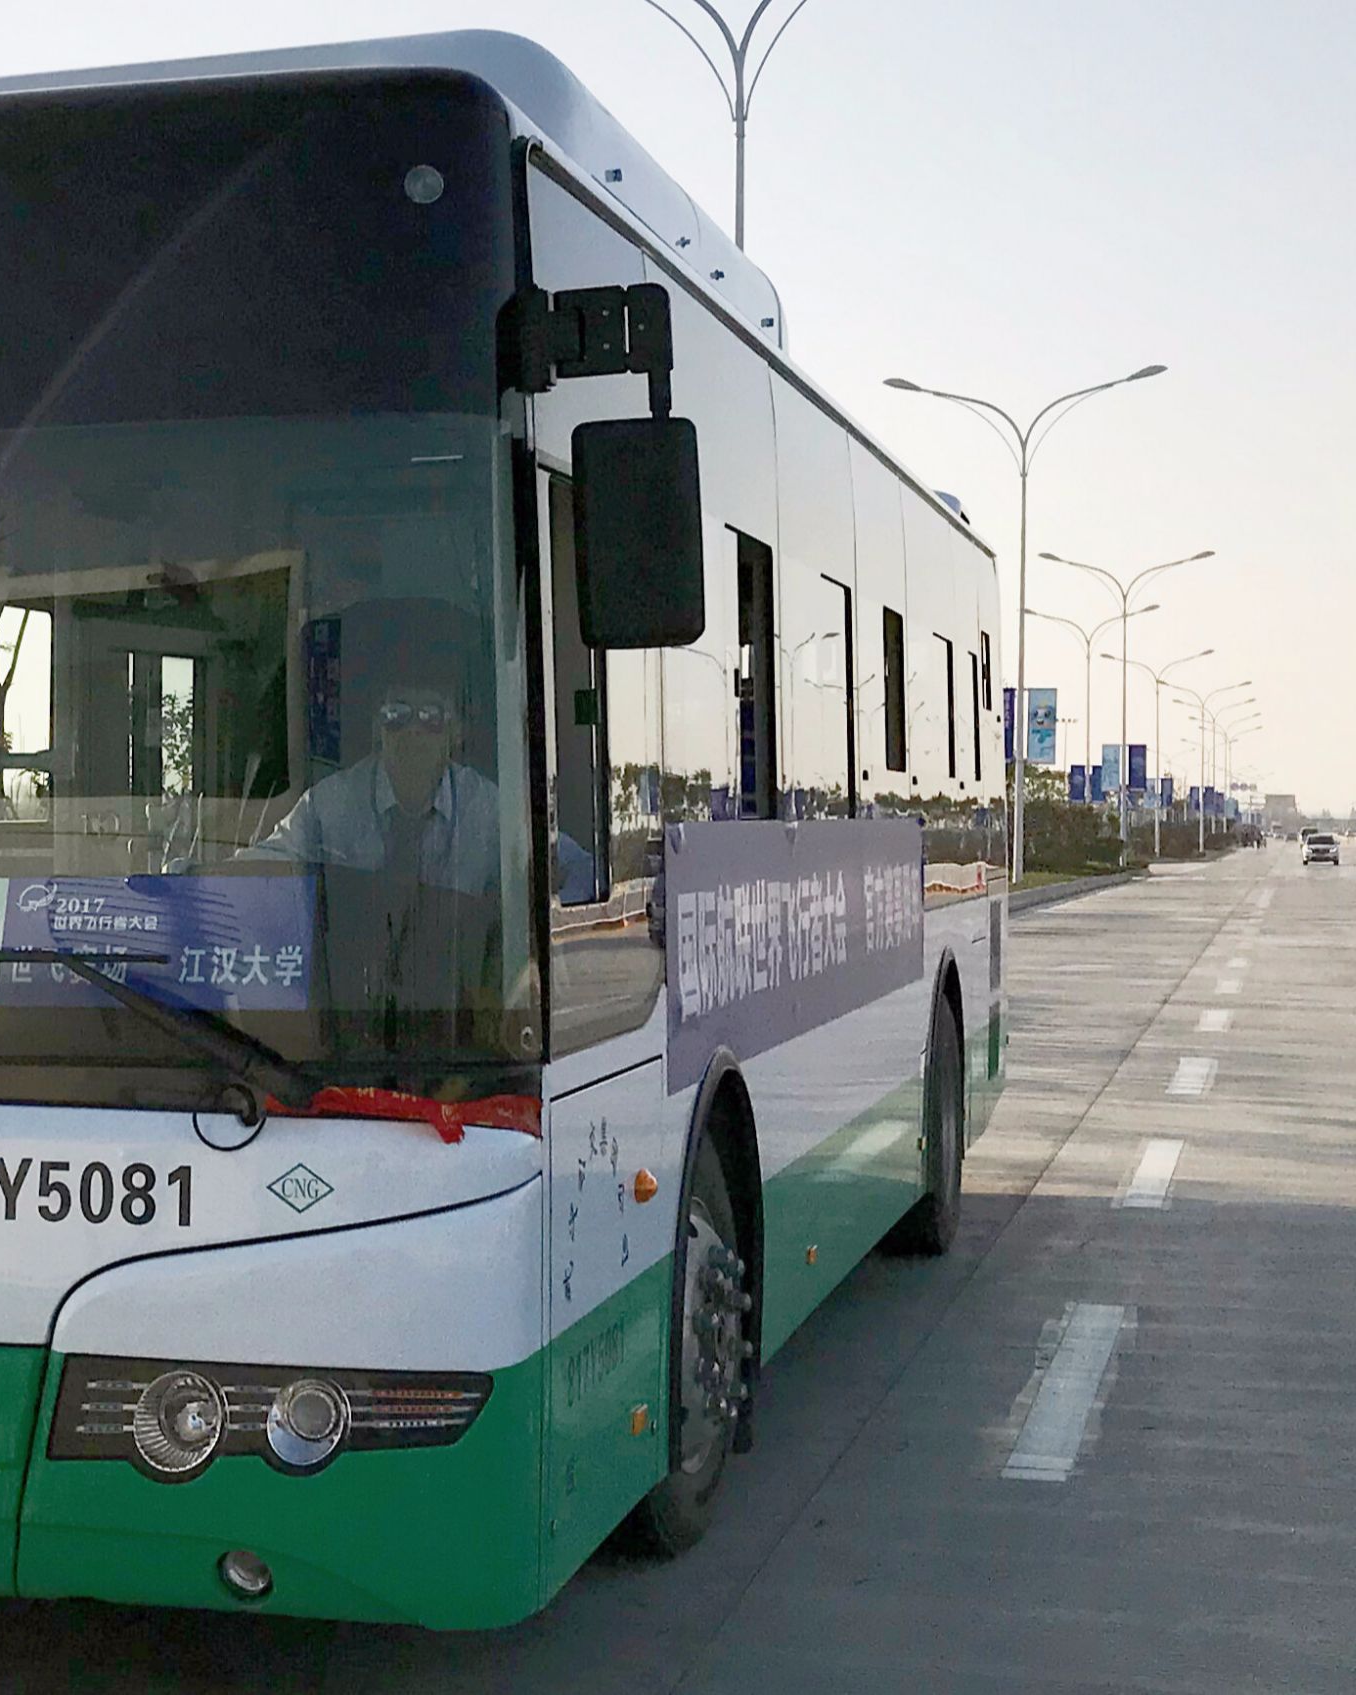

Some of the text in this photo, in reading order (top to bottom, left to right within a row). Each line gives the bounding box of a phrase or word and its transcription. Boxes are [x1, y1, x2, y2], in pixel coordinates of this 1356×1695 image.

[56, 897, 106, 914] 2017
[53, 914, 159, 932] 世界飞行者大会
[178, 944, 304, 987] 江汉大学
[281, 1178, 319, 1199] CNG
